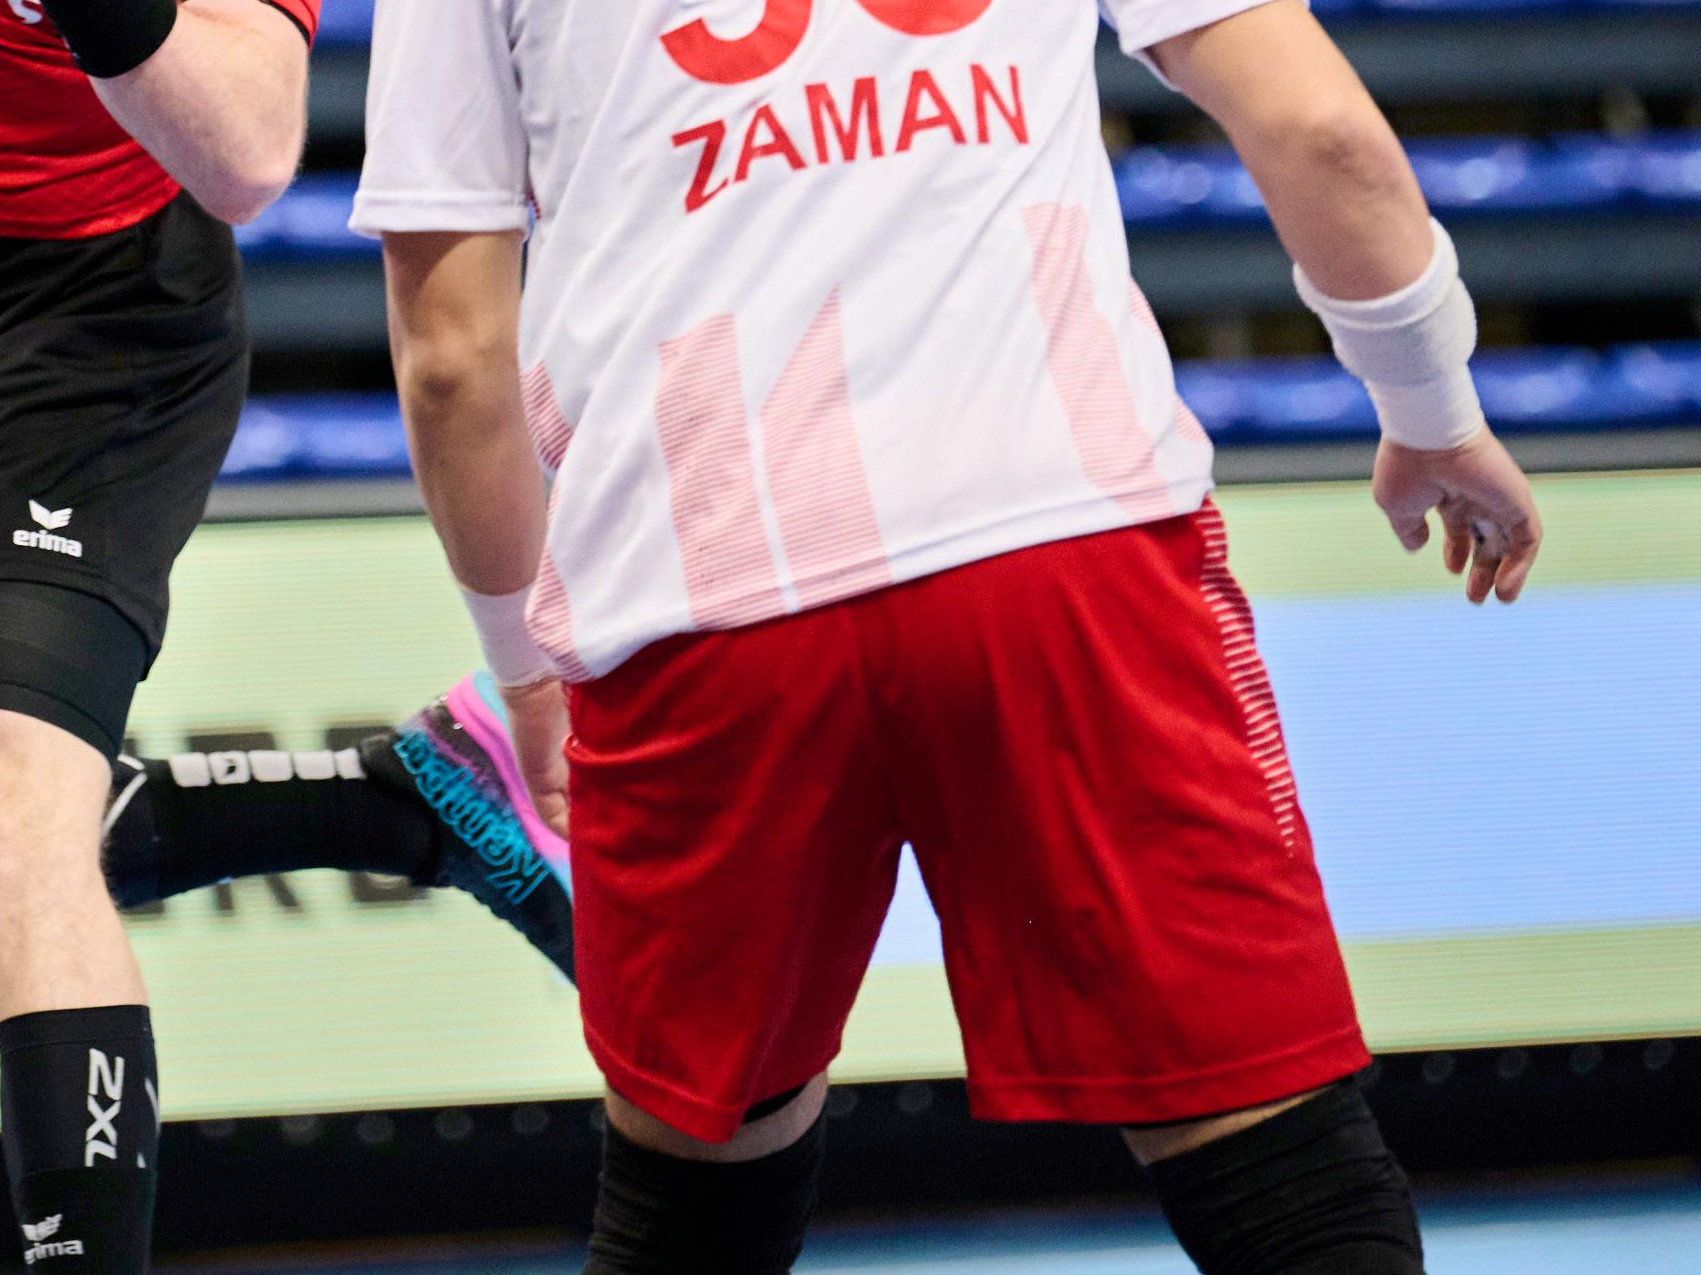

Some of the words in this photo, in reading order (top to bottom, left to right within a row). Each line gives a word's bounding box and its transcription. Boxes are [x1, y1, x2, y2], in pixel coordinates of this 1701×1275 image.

[672, 63, 1030, 215] ZAMAN
[13, 529, 83, 558] erima
[393, 732, 551, 905] Kempa
